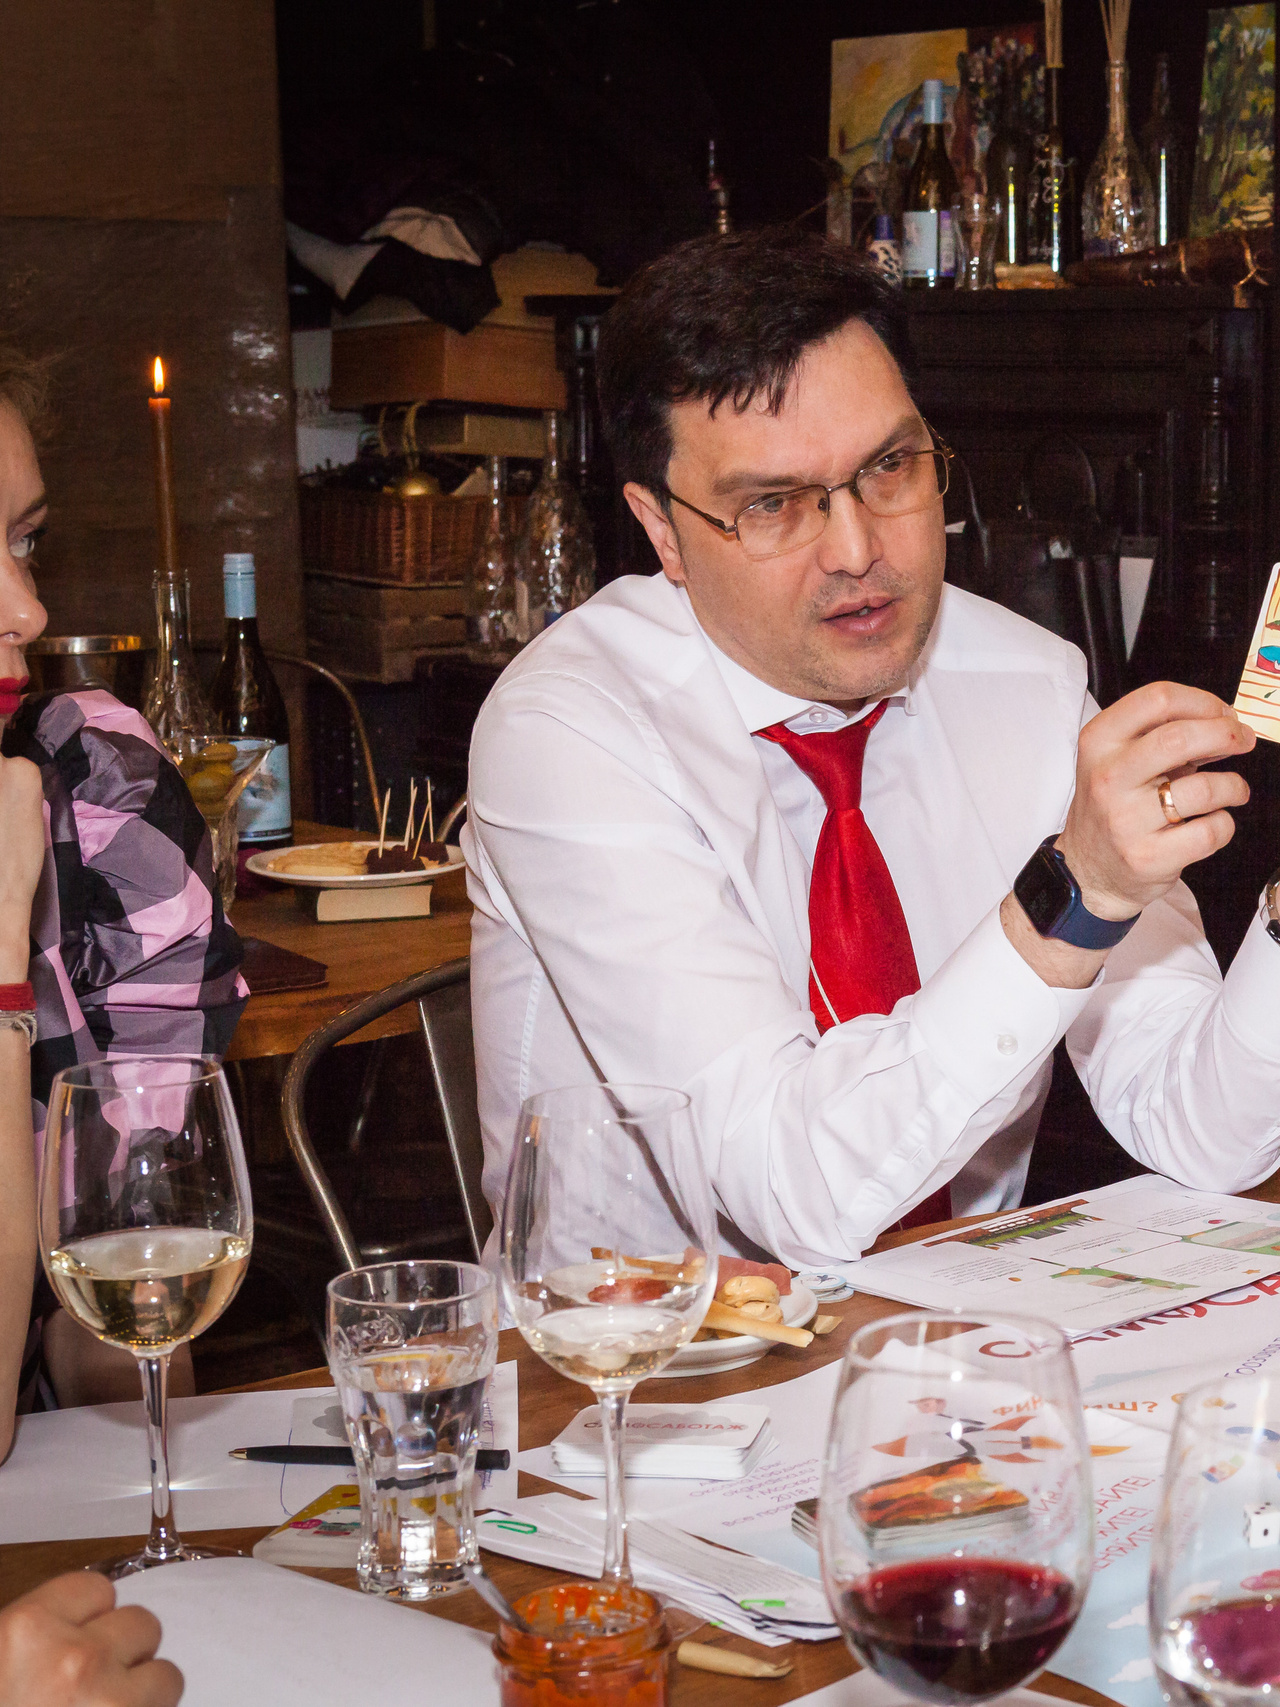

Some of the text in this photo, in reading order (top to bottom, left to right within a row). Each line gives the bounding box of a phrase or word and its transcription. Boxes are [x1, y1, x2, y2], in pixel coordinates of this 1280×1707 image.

[583, 1421, 746, 1432] СОСАБОТАЖ
[758, 1475, 820, 1496] Москва
[769, 1488, 809, 1503] 2018
